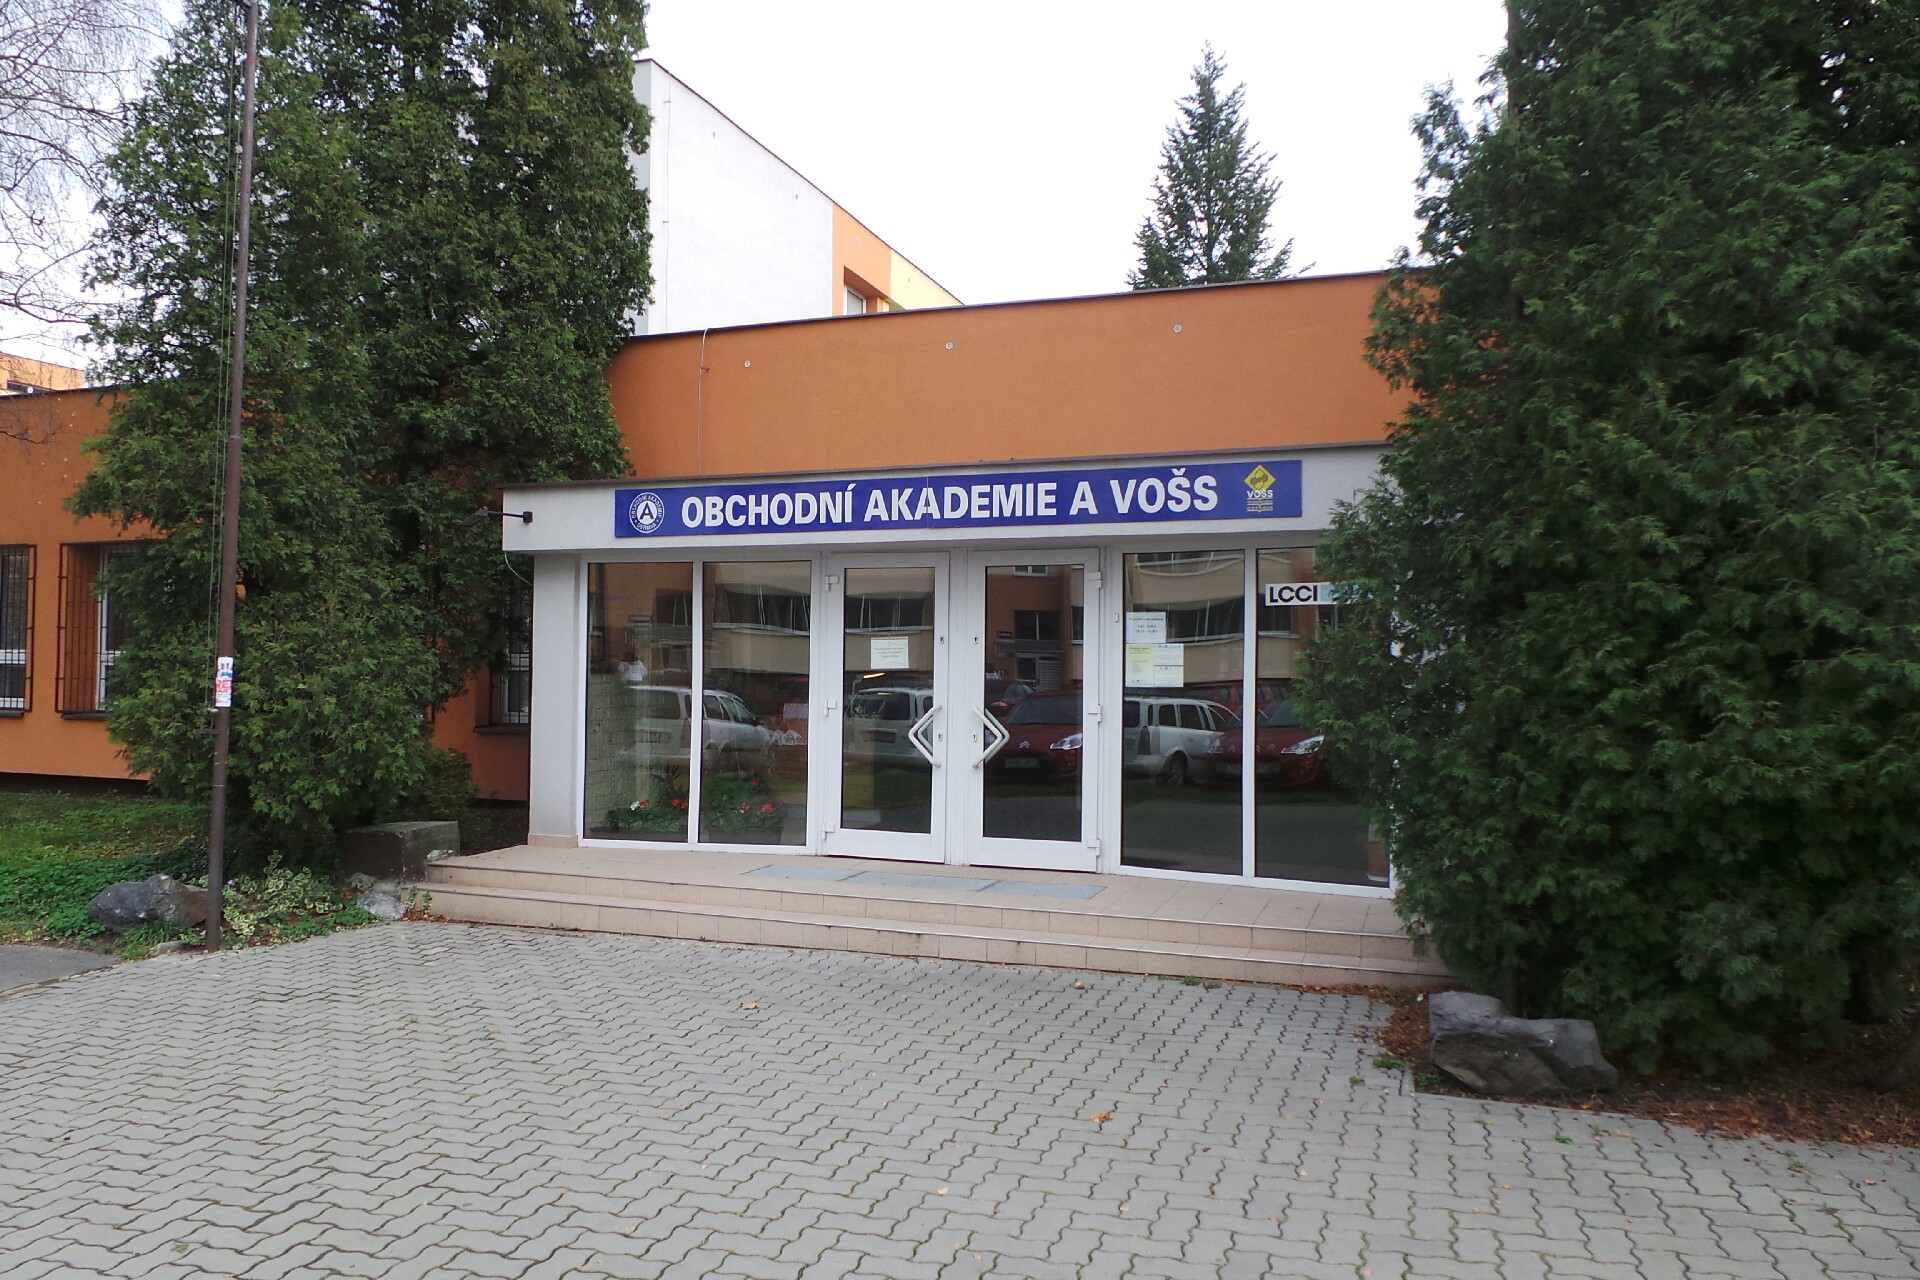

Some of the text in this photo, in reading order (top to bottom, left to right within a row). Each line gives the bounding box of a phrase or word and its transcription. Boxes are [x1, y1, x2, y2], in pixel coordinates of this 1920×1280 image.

[681, 467, 1218, 528] OBCHODNÍ AKADEMIE A VOŠS
[639, 502, 655, 520] A
[1270, 585, 1318, 604] LCCI
